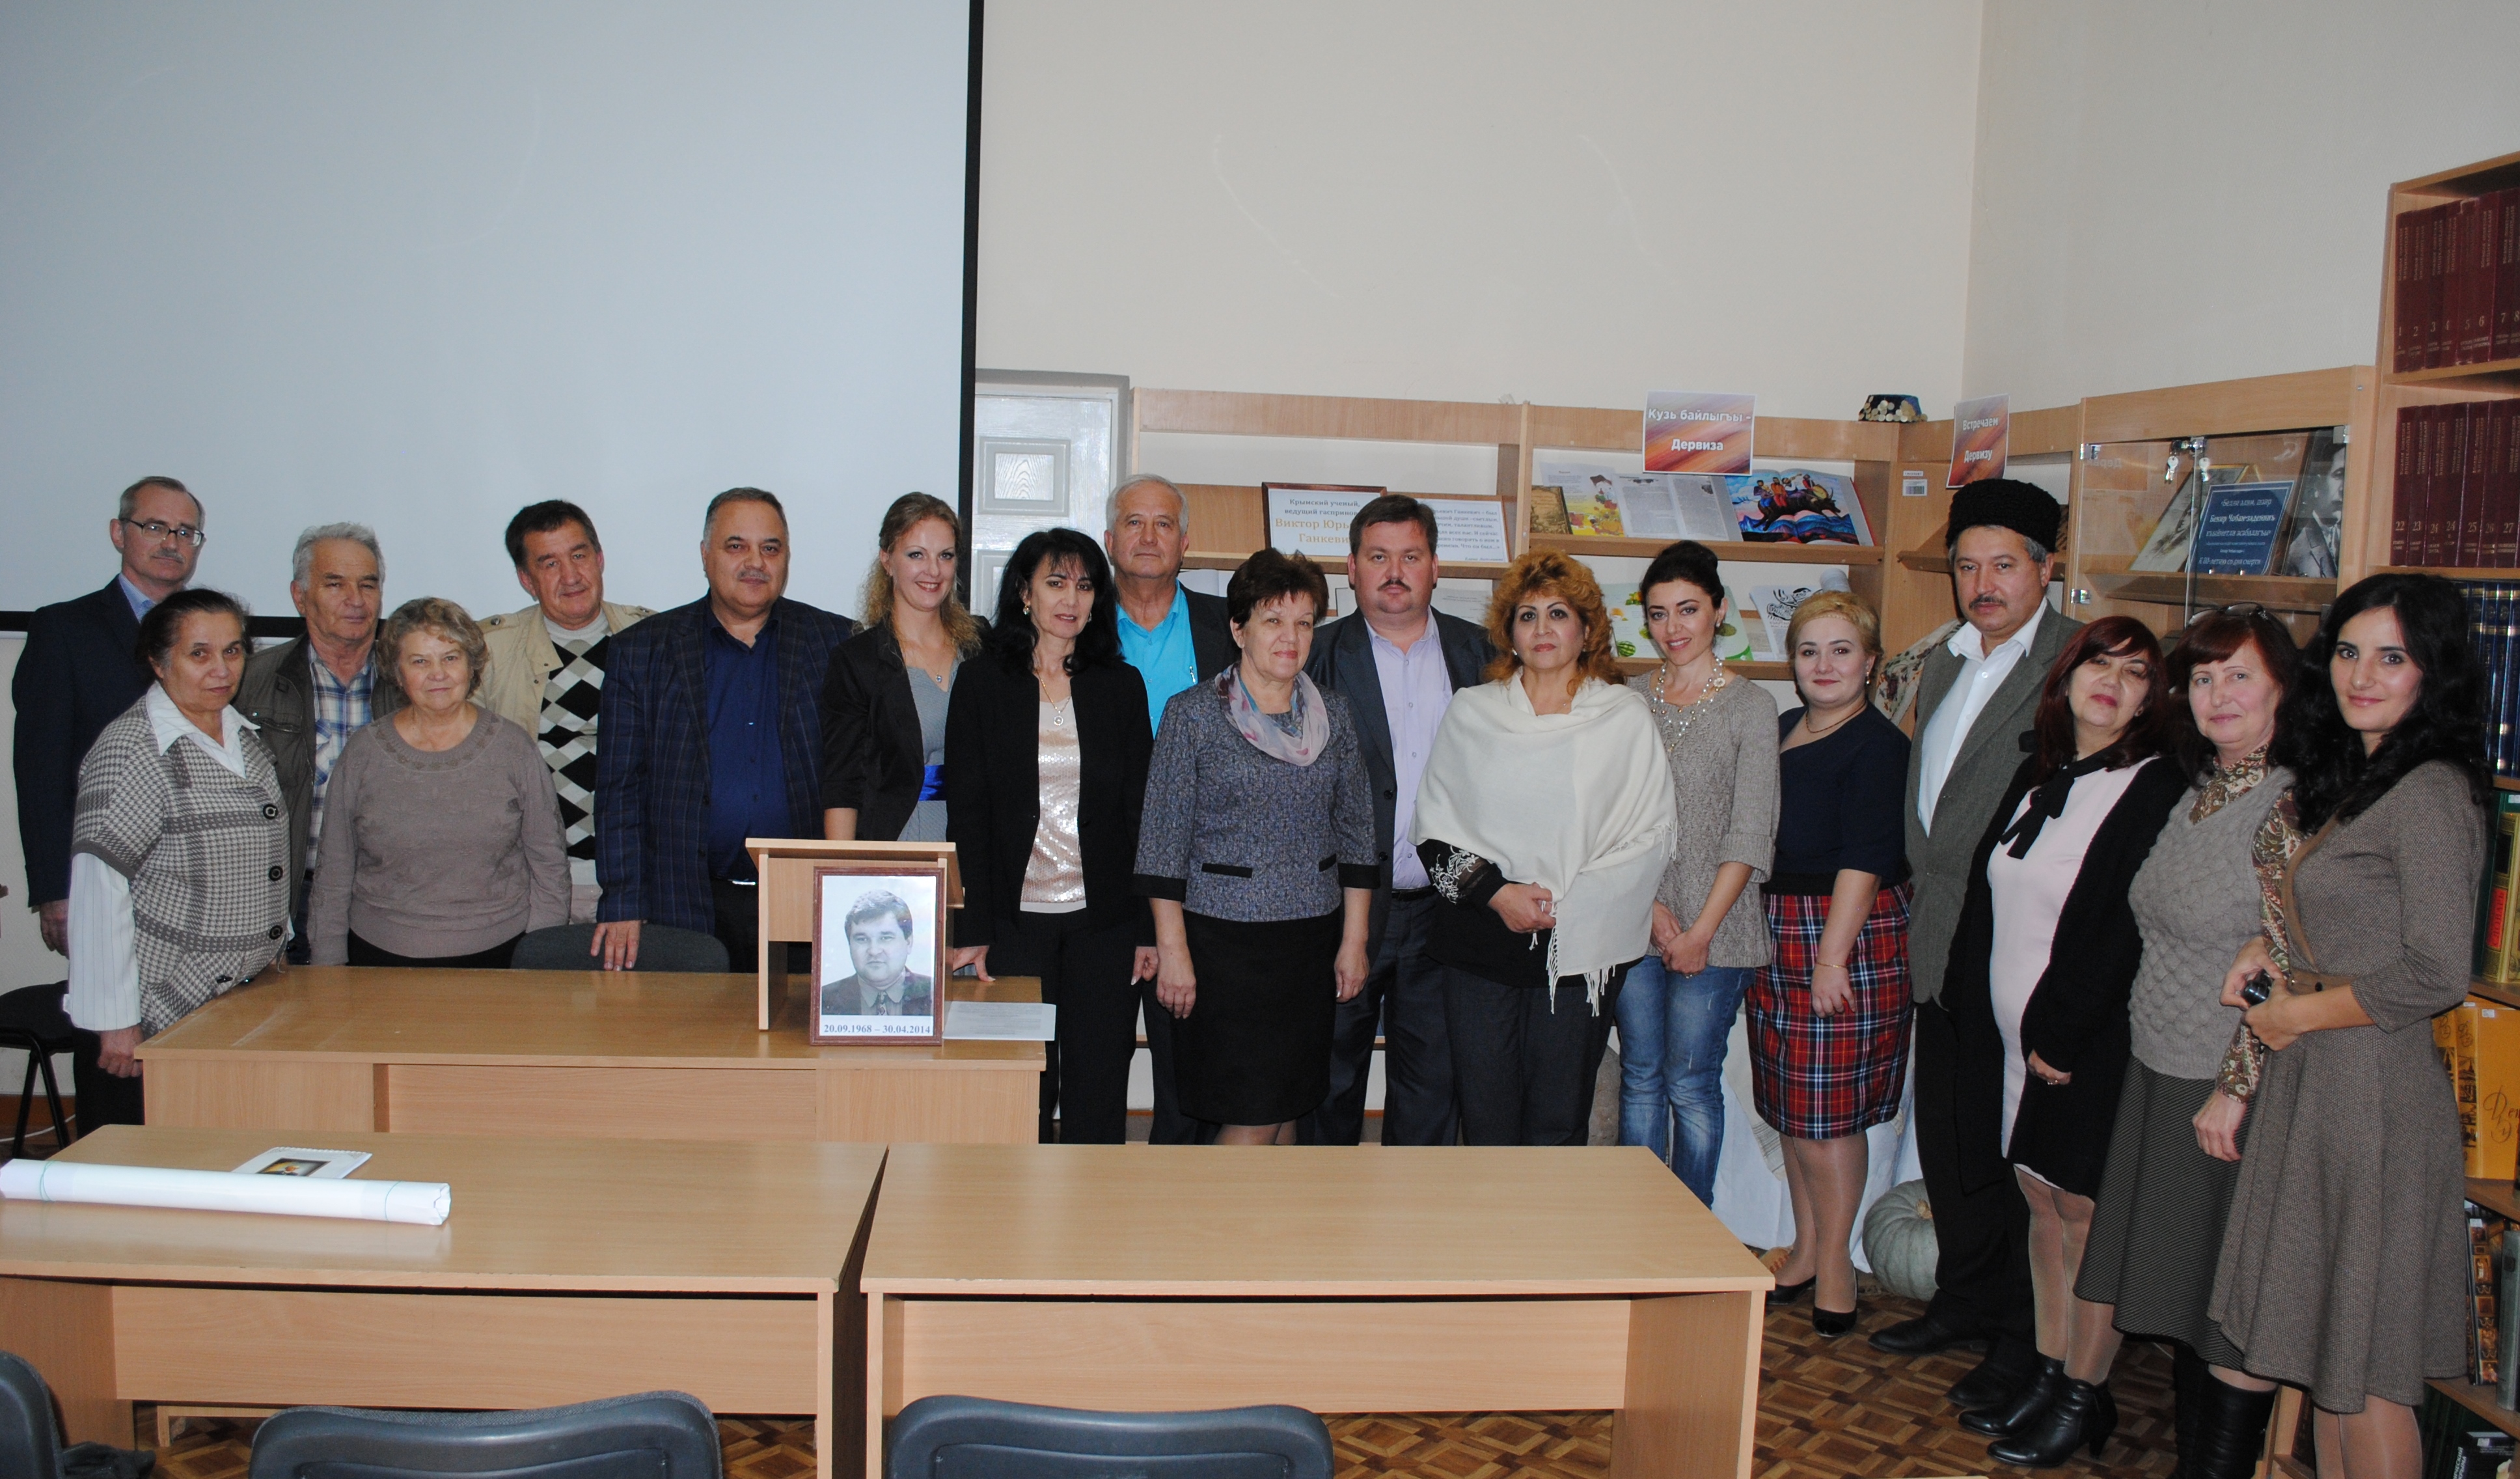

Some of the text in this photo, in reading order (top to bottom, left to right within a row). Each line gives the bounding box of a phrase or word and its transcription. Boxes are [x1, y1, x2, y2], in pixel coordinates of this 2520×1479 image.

[2478, 315, 2485, 327] 6
[2501, 312, 2506, 323] 7
[2514, 311, 2520, 322] 8
[2430, 322, 2435, 332] 3
[2445, 320, 2449, 330] 4
[2465, 319, 2471, 330] 5
[2398, 326, 2402, 336] 1
[2413, 326, 2418, 337] 2
[1648, 408, 1677, 421] Кузь
[1680, 409, 1742, 422] байлыгъы
[1963, 417, 1999, 431] Встречаем
[1671, 438, 1723, 452] Дервиза
[1964, 449, 1993, 463] Дервизу
[1276, 518, 1319, 530] Виктор
[2396, 521, 2405, 531] 22
[2412, 521, 2421, 531] 23
[2430, 523, 2439, 534] 24
[2446, 521, 2456, 531] 24
[2467, 521, 2477, 532] 25
[2485, 523, 2494, 533] 26
[2503, 522, 2514, 533] 27
[824, 1025, 872, 1033] 20.09.1968
[883, 1025, 930, 1034] 30.04.2014
